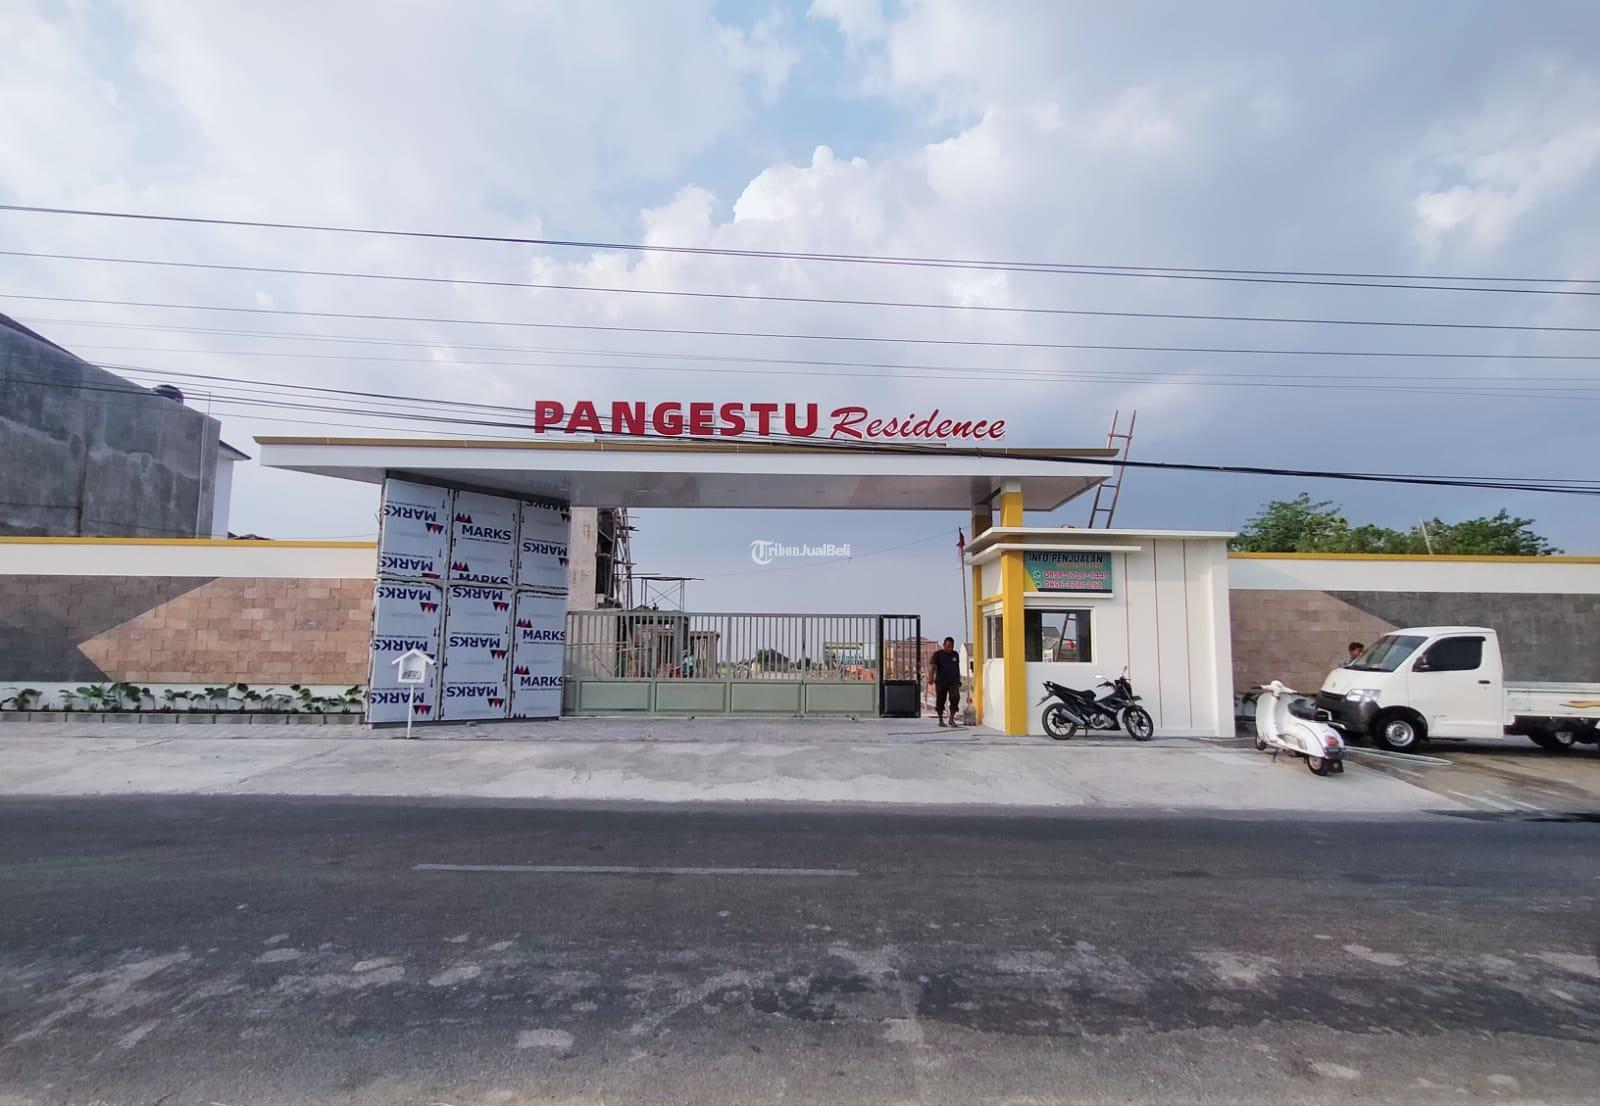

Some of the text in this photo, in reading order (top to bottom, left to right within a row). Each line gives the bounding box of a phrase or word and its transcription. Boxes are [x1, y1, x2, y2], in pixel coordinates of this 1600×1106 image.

[534, 401, 1005, 439] PANGESTU Residence
[384, 504, 436, 522] MARKS
[462, 524, 512, 540] MARKS
[523, 542, 567, 557] MARKS
[381, 556, 433, 572] MARKS
[1029, 552, 1103, 563] INFO PENJUALAN
[377, 586, 431, 601] MARKS
[452, 587, 504, 601] MARKS
[523, 629, 566, 641] MARKS
[374, 639, 428, 652] MARKS
[449, 636, 500, 649] MARKS
[520, 676, 564, 687] MARKS
[370, 692, 424, 704] MARKS
[446, 686, 497, 698] MARKS
